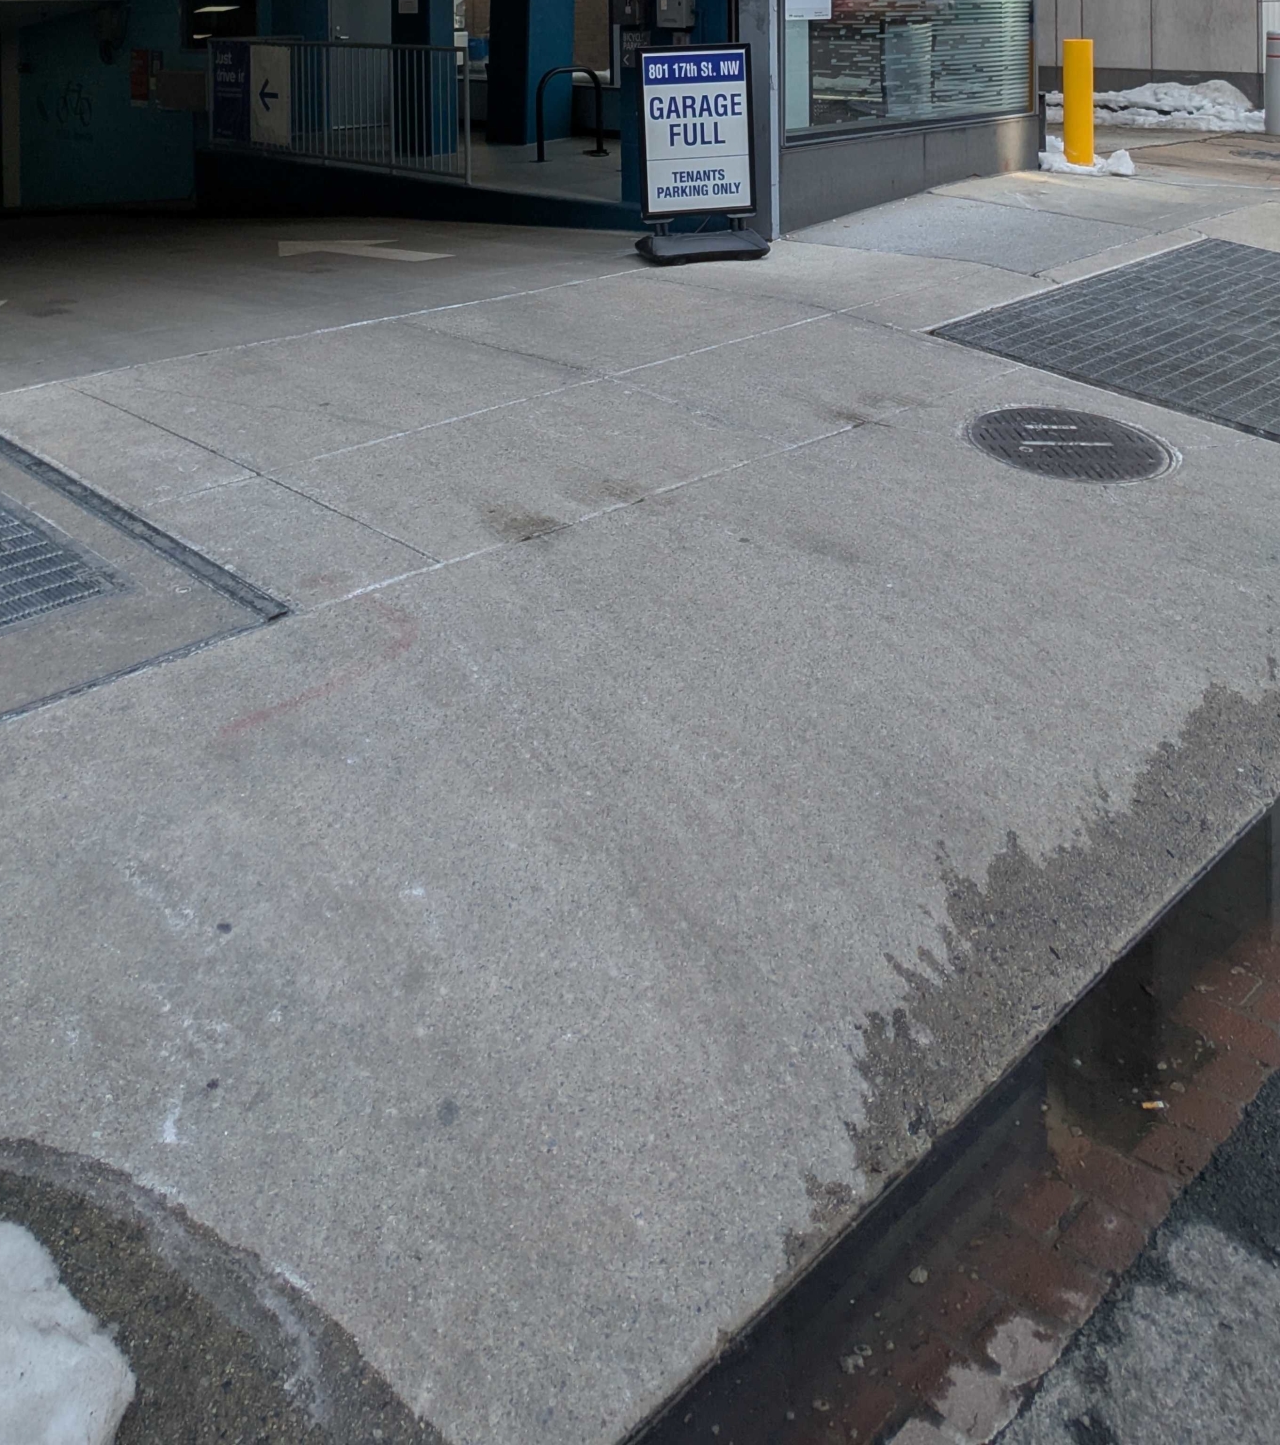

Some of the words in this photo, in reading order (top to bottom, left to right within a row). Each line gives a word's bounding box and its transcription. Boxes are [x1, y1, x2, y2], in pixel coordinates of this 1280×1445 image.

[648, 63, 669, 79] 801
[673, 62, 698, 78] 17th
[700, 61, 716, 77] St.
[720, 60, 740, 76] NW
[649, 93, 742, 120] GARAGE
[669, 121, 726, 147] FULL
[672, 169, 725, 183] TENANTS
[656, 184, 709, 199] PARKING
[712, 182, 741, 195] ONLY
